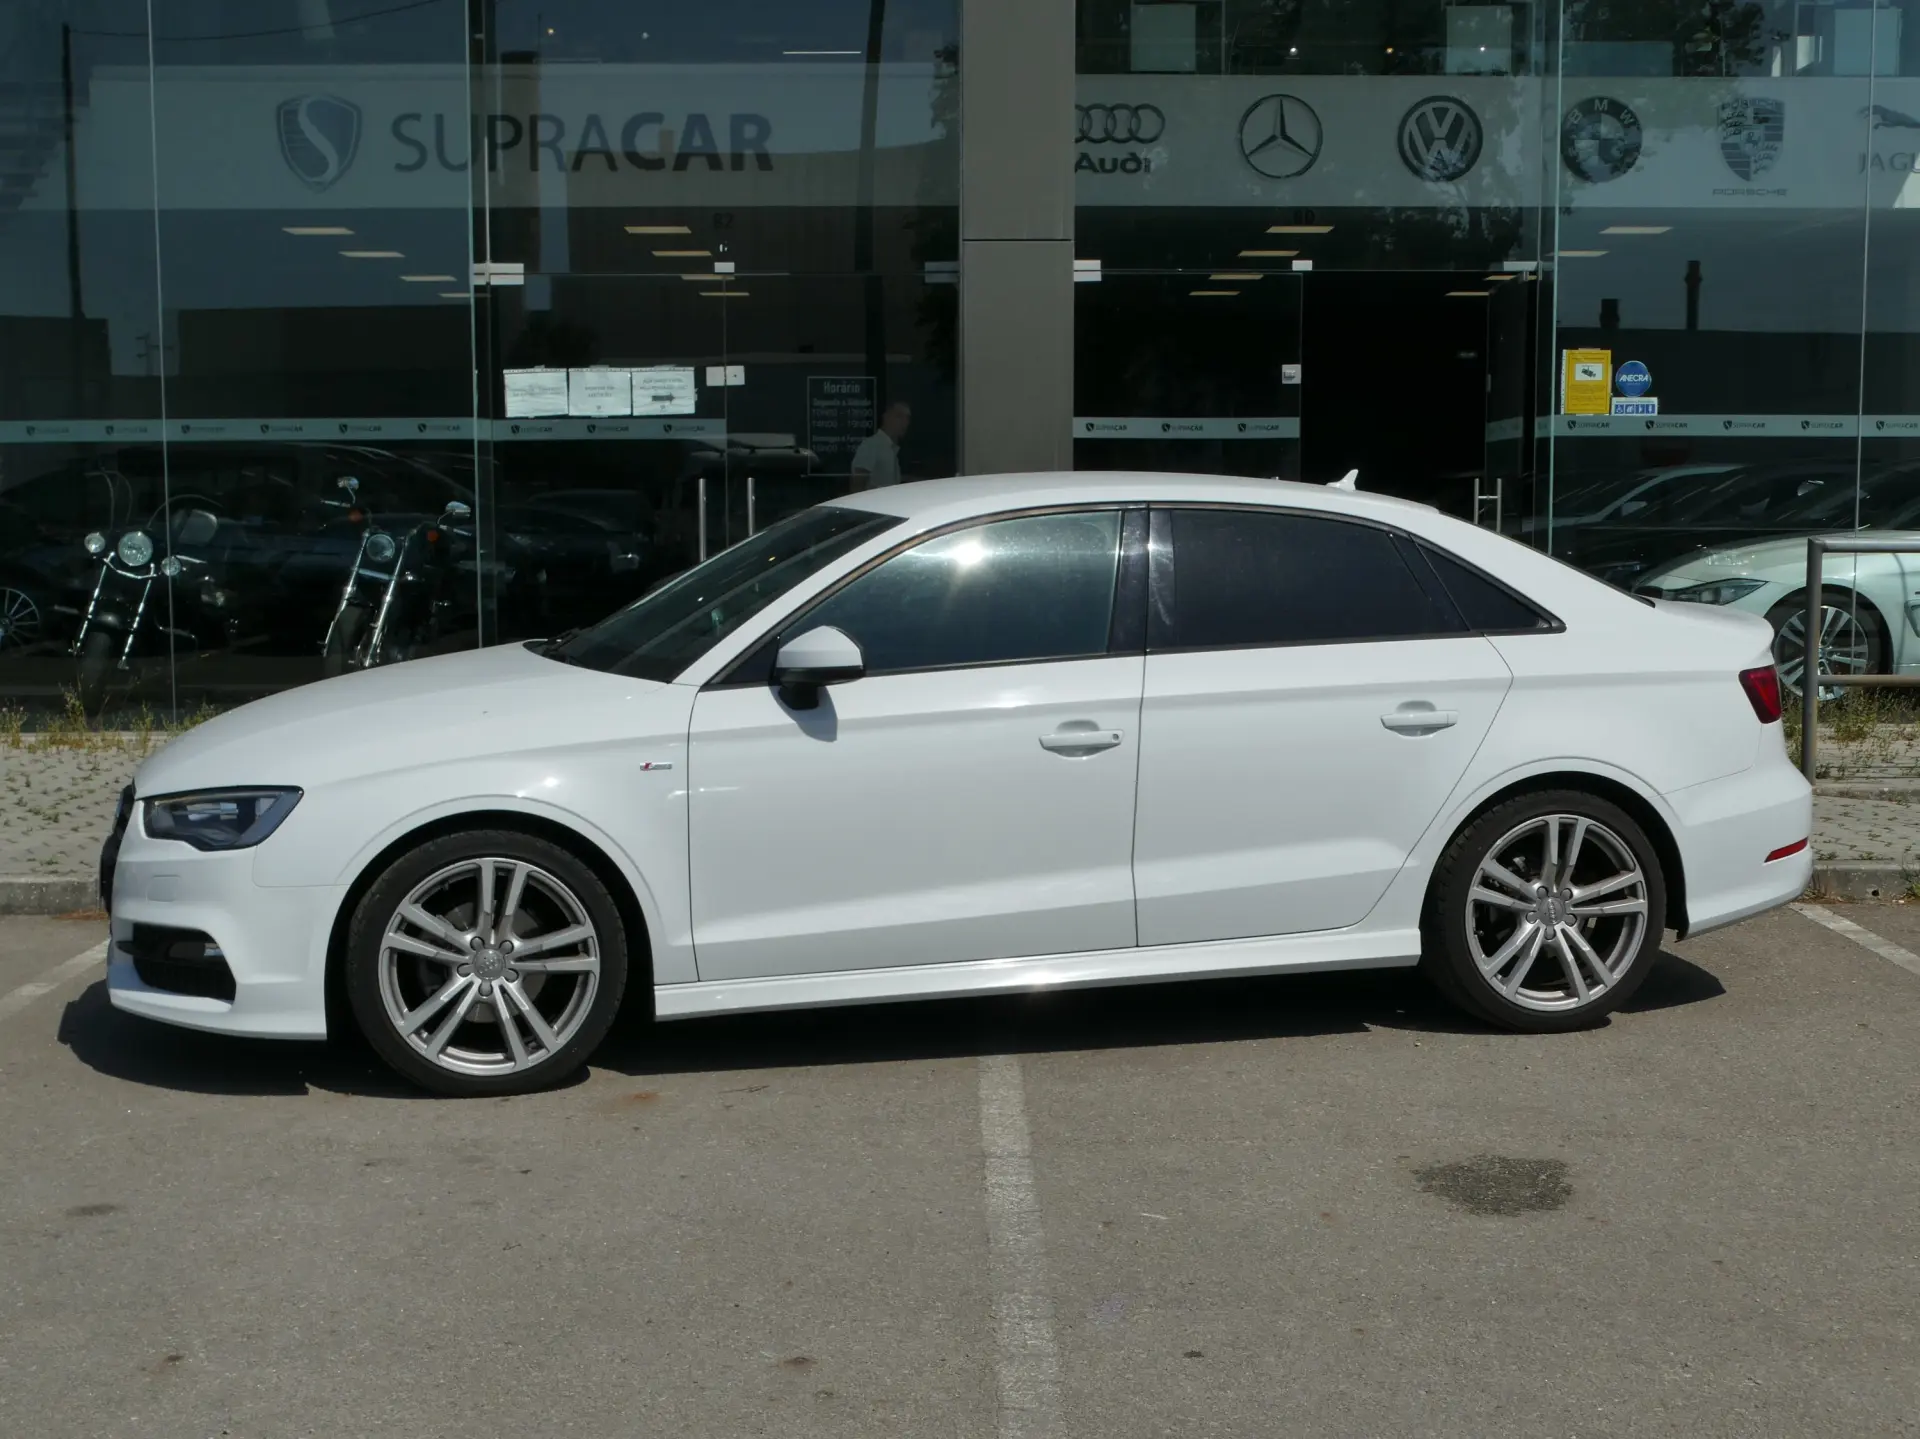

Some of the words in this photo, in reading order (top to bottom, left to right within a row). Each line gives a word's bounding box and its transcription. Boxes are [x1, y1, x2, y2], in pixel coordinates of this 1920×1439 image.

[1568, 99, 1635, 125] BMW
[391, 112, 774, 172] SUPRACAR
[1075, 152, 1151, 174] Audi
[1712, 188, 1789, 197] PORSCHE
[1619, 374, 1649, 382] ANECRA
[823, 381, 861, 394] Horário
